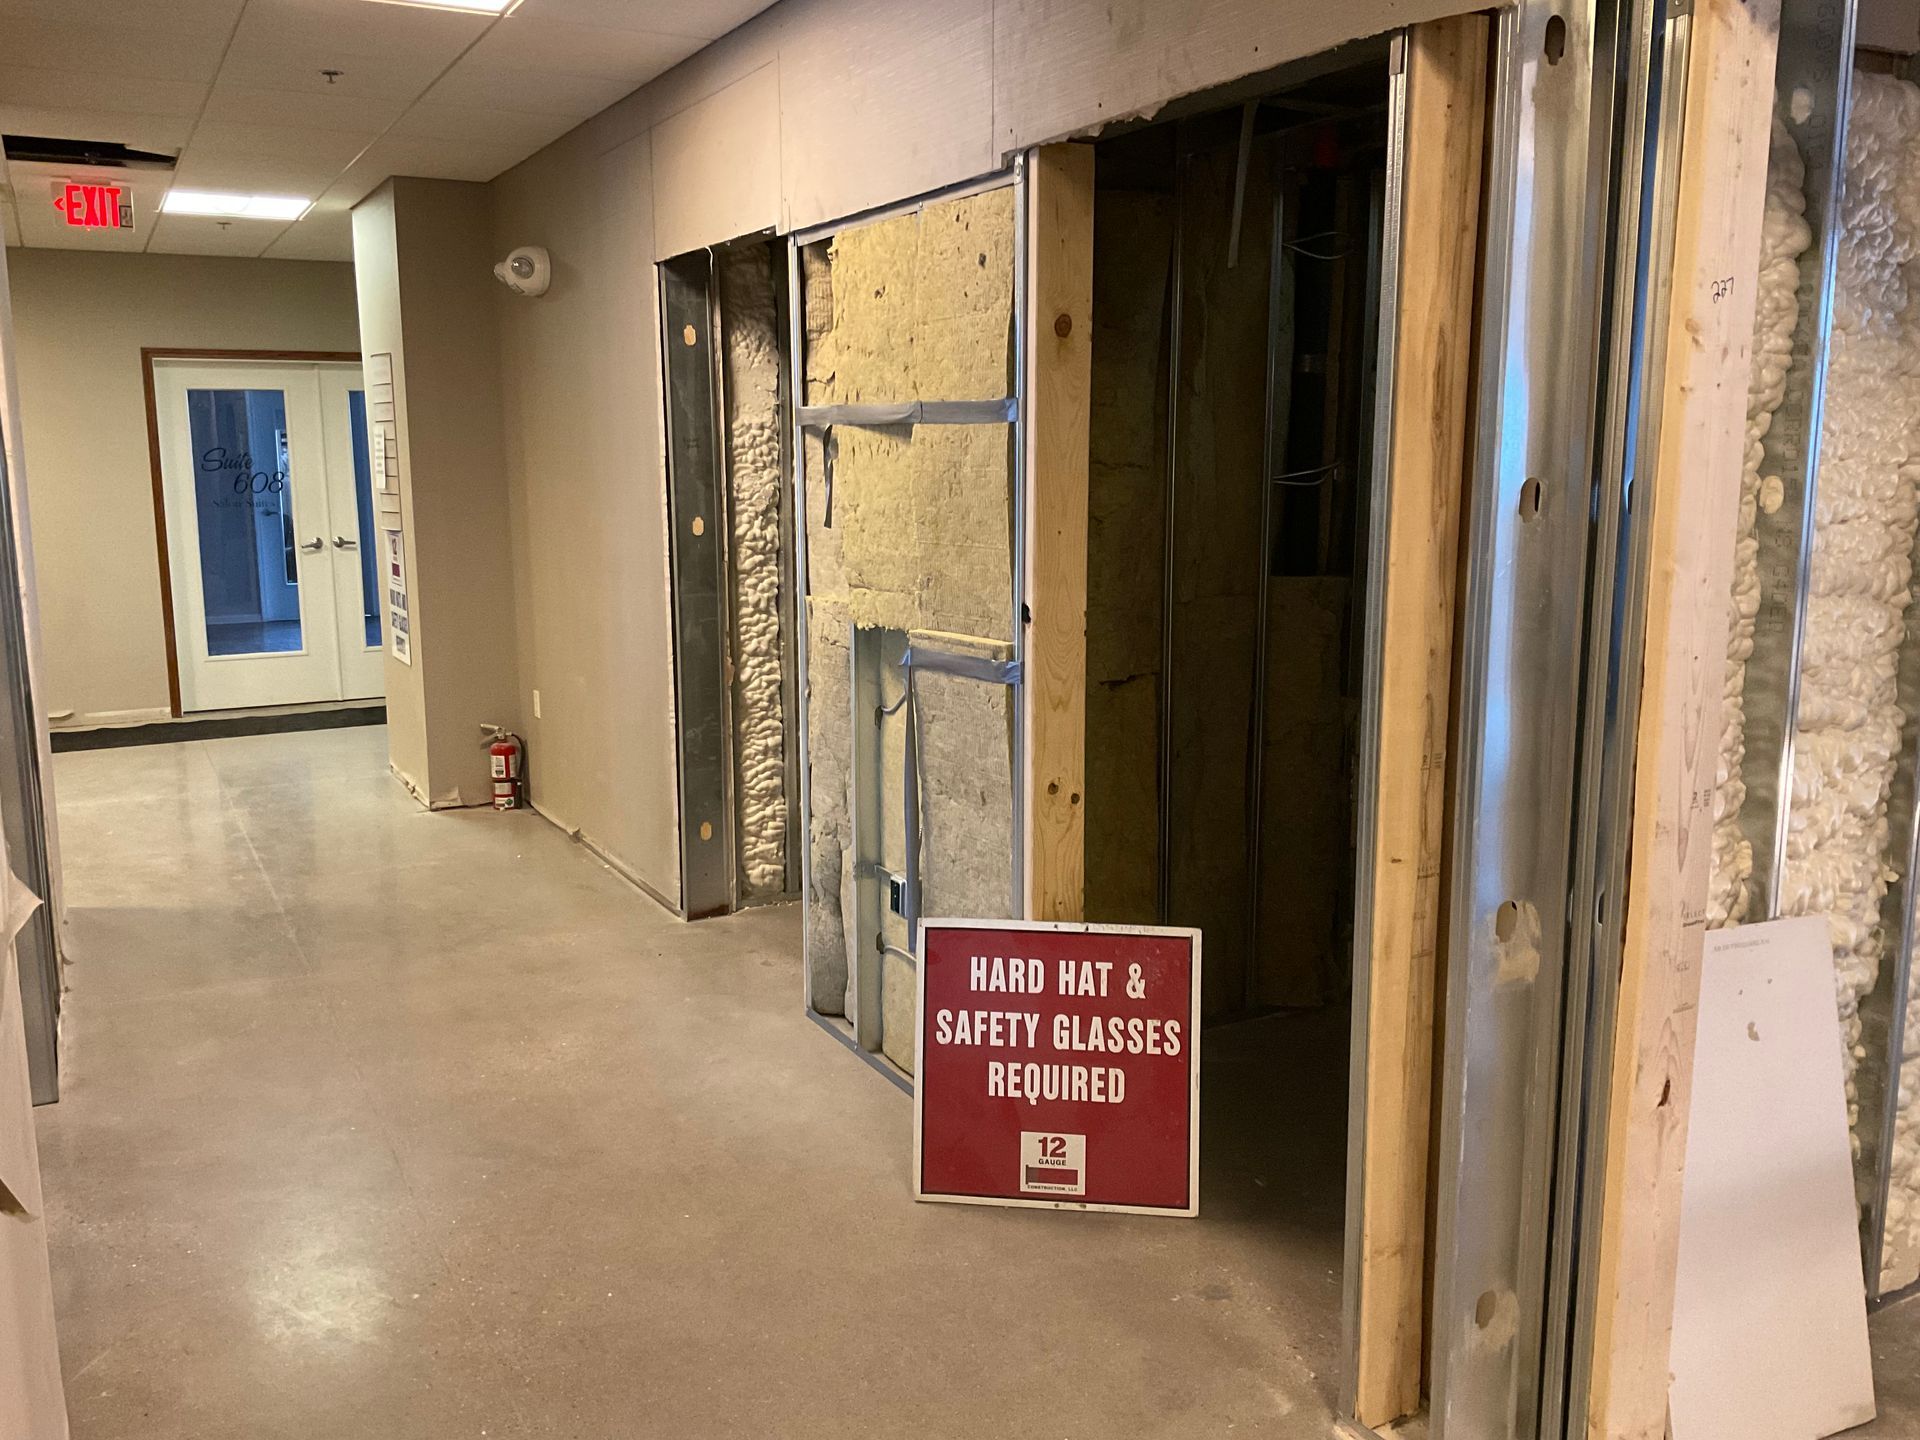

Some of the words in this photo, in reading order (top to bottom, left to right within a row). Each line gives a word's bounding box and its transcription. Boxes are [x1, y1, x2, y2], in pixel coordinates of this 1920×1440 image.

[65, 185, 121, 227] EXIT
[1711, 276, 1734, 304] 227
[201, 447, 253, 472] Suite
[234, 471, 285, 494] 608
[970, 956, 1045, 994] HARD
[1058, 959, 1113, 997] HAT
[1125, 962, 1146, 999] &
[935, 1008, 1040, 1048] SAFETY
[1052, 1013, 1181, 1056] GLASSES
[988, 1061, 1125, 1106] REQUIRED
[1038, 1136, 1067, 1158] 12
[1038, 1158, 1067, 1166] GAUGE
